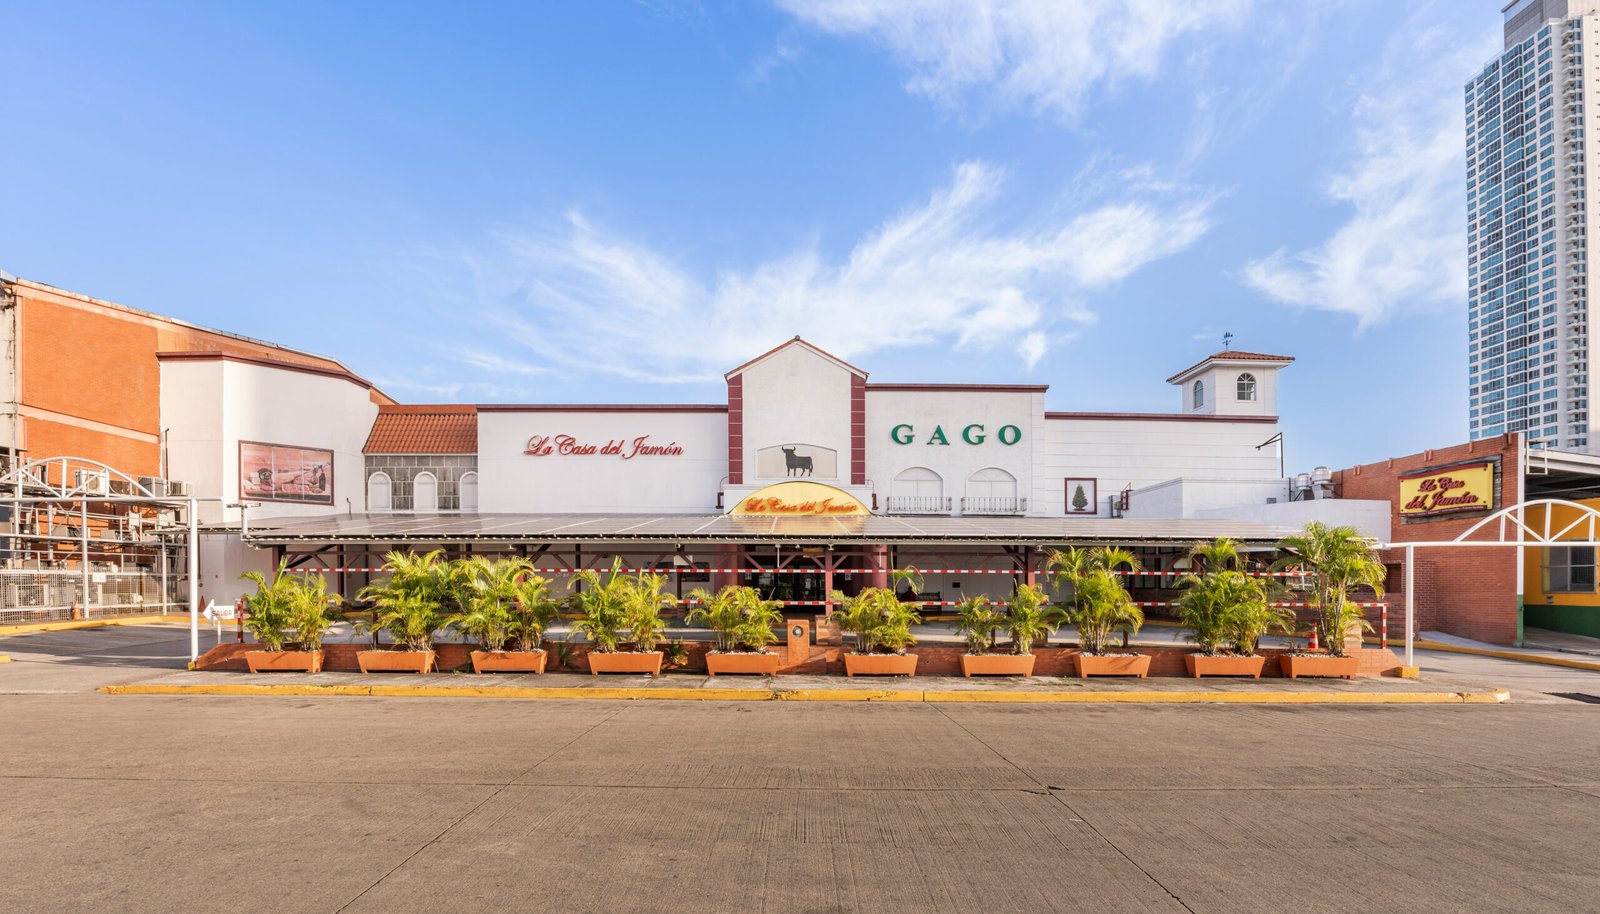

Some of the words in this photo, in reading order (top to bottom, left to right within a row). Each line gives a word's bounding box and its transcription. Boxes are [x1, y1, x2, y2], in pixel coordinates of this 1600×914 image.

[890, 423, 1022, 446] GAGO
[523, 435, 553, 456] La
[554, 434, 597, 455] Casa
[600, 440, 625, 455] del
[622, 434, 684, 459] Jamón
[1417, 479, 1437, 492] La
[1437, 477, 1465, 490] Casa
[745, 497, 766, 512] La
[766, 497, 798, 512] Casa
[799, 500, 816, 512] del
[1405, 494, 1429, 510] del
[1423, 488, 1479, 510] Jamón
